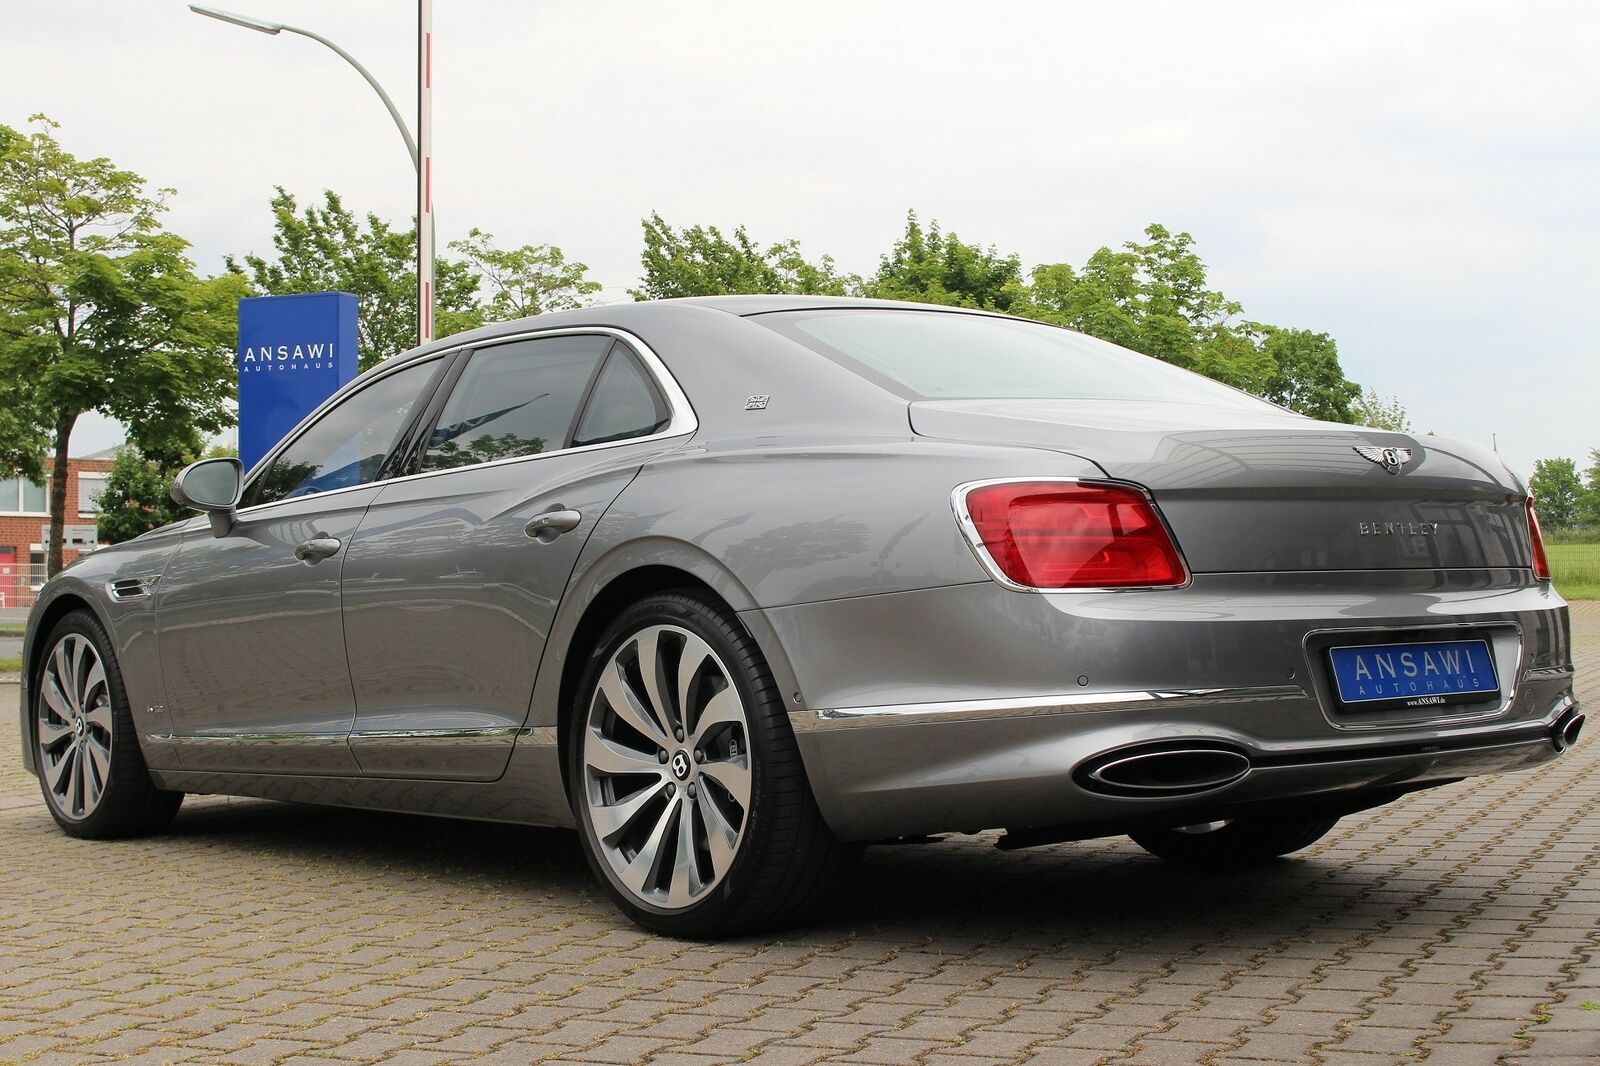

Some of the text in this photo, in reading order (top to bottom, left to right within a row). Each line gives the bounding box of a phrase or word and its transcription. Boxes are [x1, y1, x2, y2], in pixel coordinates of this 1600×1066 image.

[244, 343, 333, 362] ANSAWI
[244, 362, 333, 372] AUTOHAUS
[1360, 522, 1438, 535] BENTLEY
[1356, 650, 1475, 680] ANSAWI
[1359, 678, 1479, 695] AUTOHAUS
